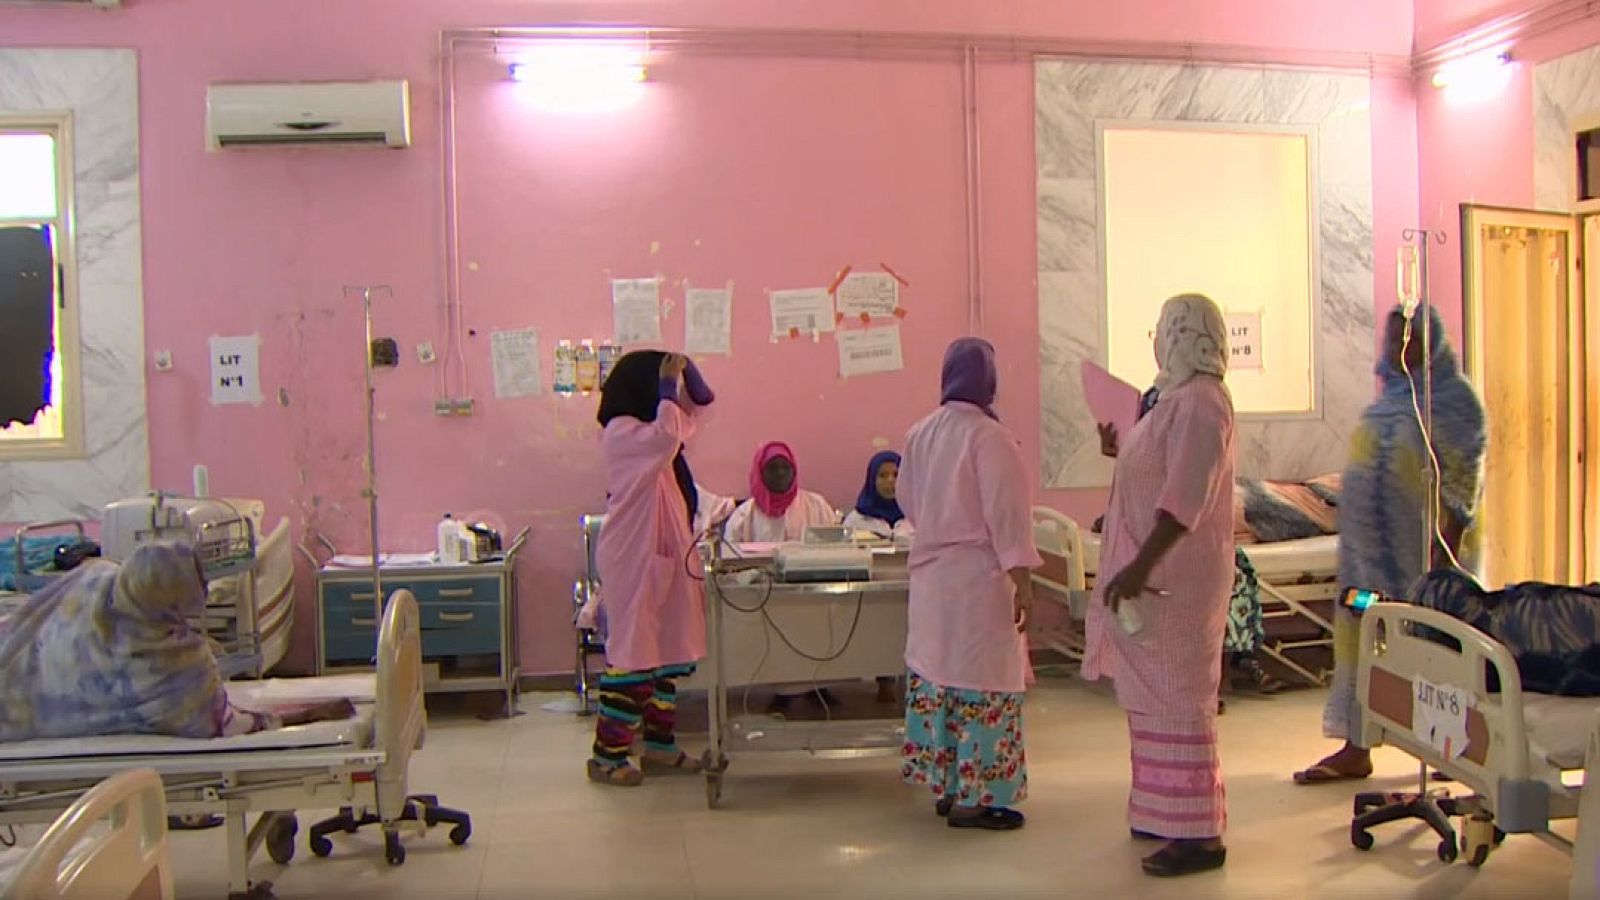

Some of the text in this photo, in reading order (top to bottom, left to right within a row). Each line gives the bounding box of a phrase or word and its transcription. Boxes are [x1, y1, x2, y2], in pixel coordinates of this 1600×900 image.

[1232, 327, 1248, 336] LIT
[220, 355, 242, 366] LIT
[1418, 680, 1435, 706] LIT
